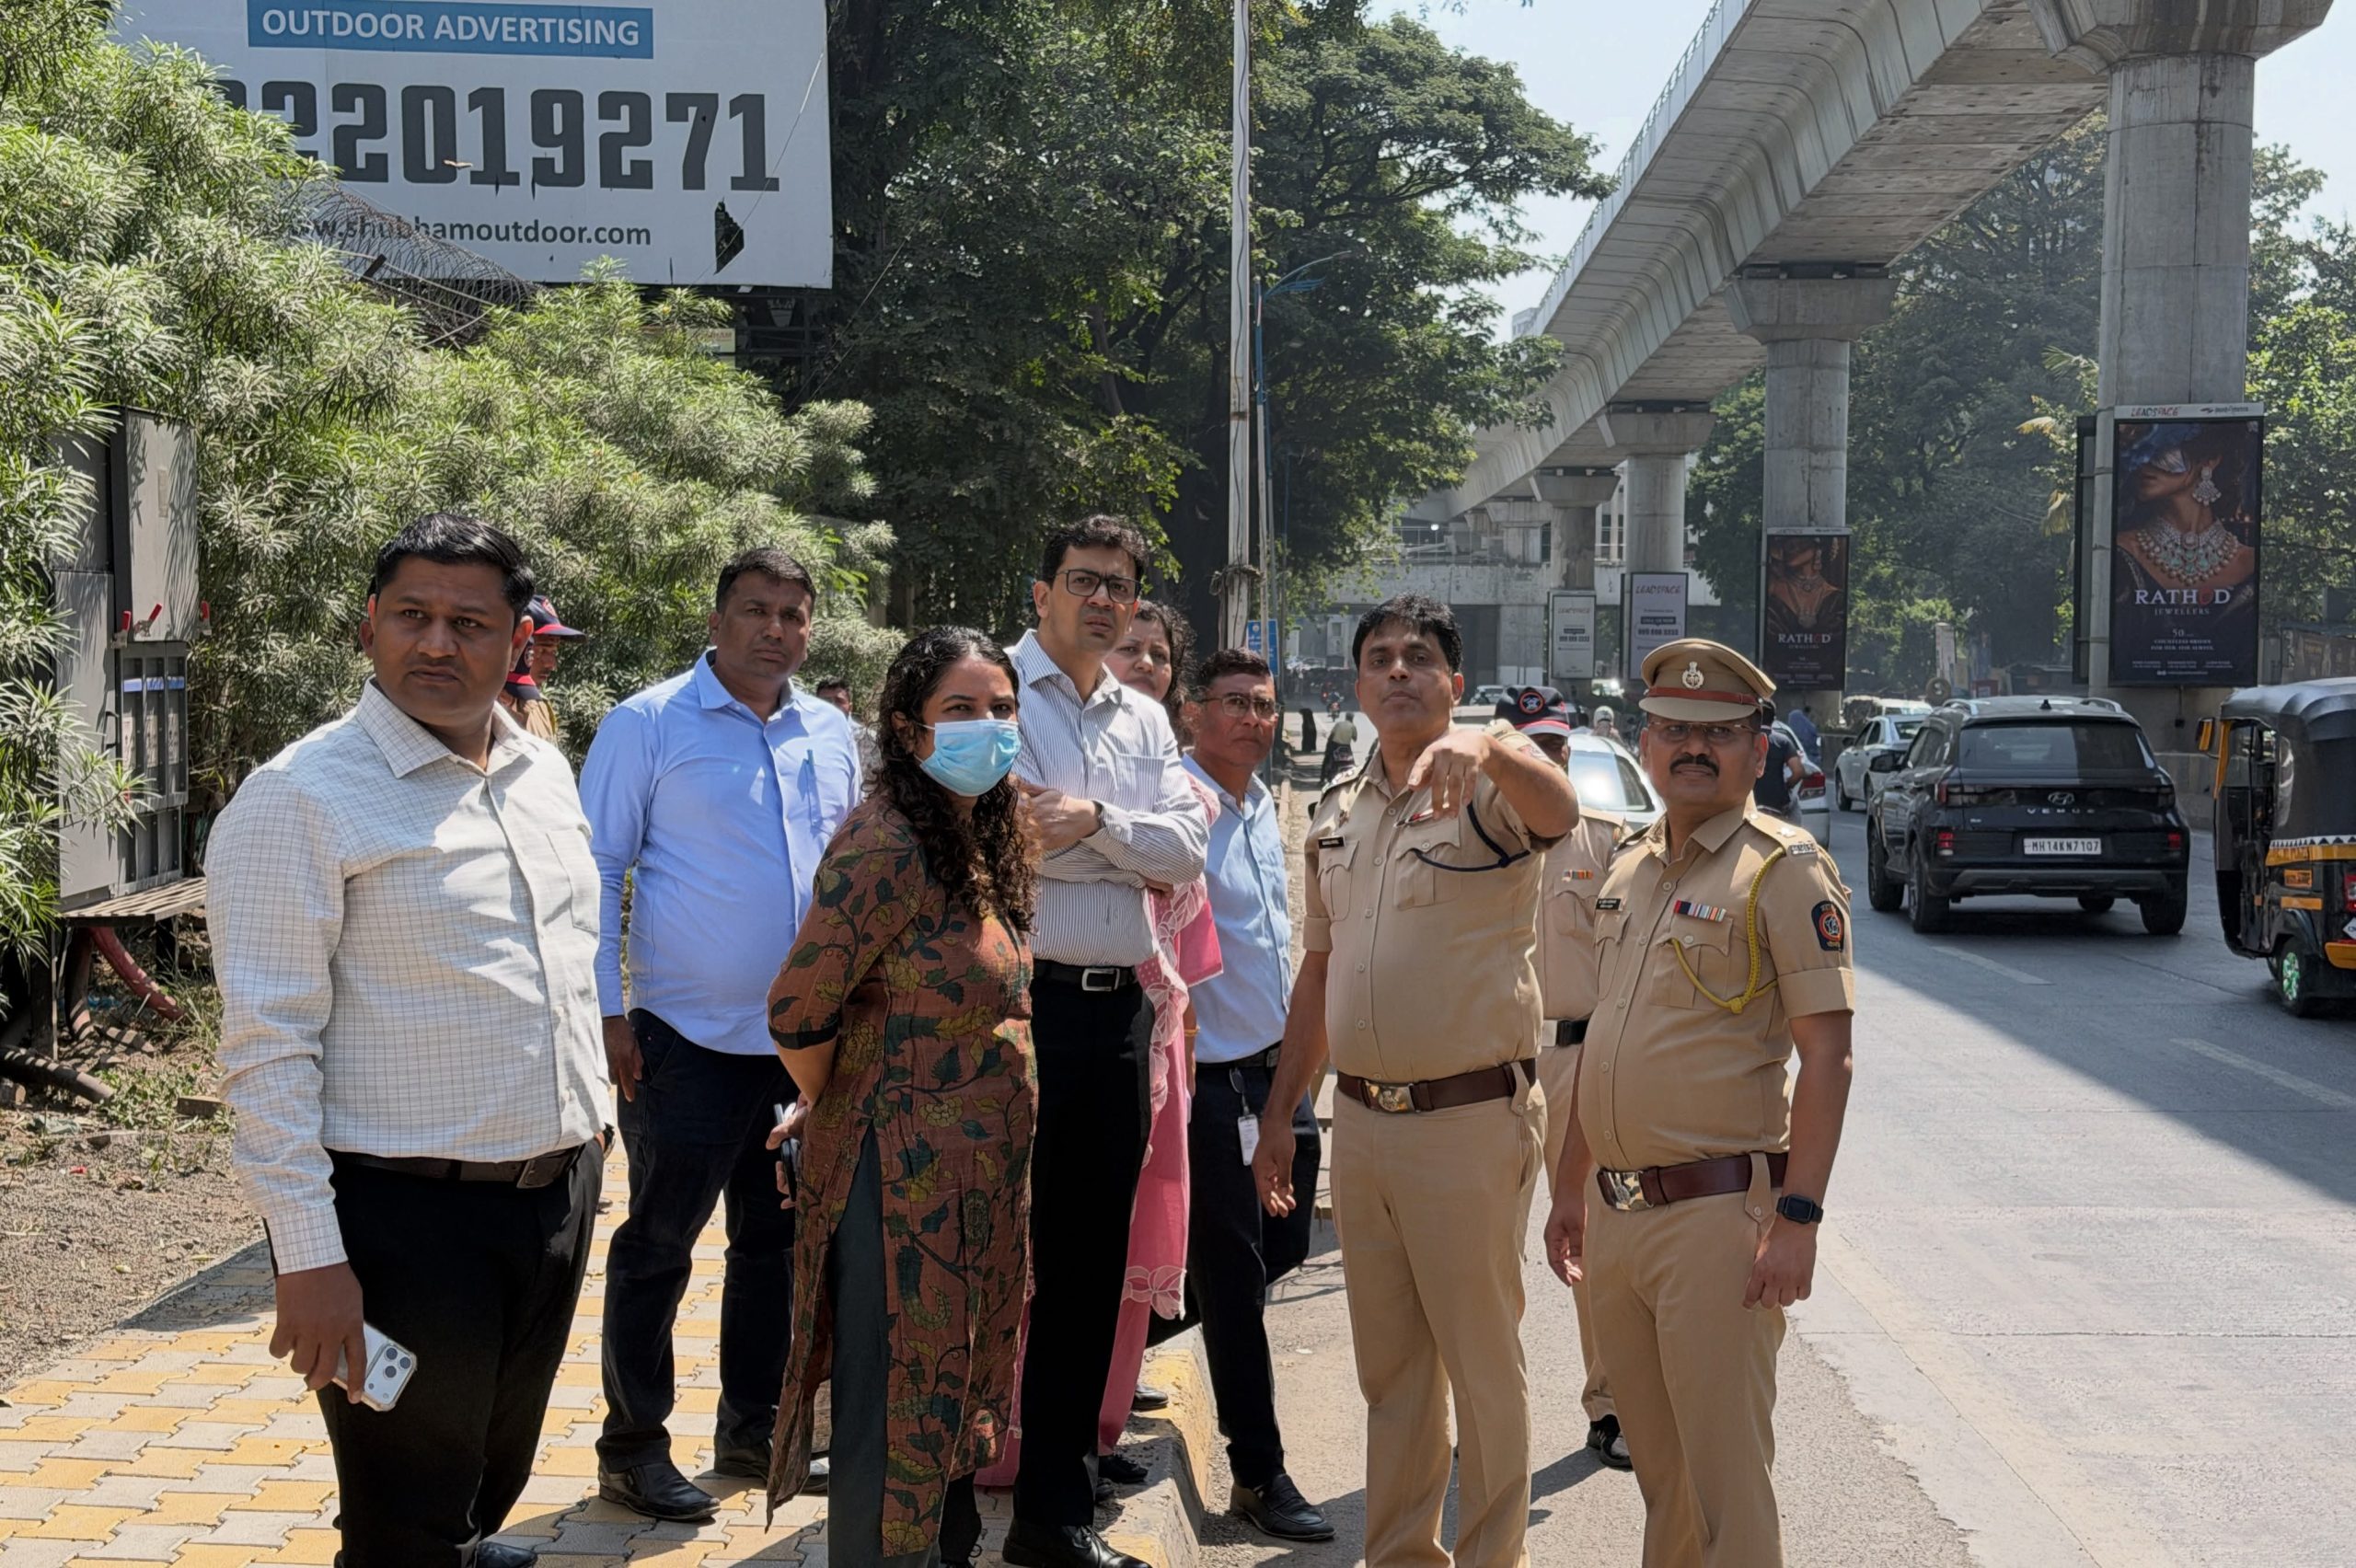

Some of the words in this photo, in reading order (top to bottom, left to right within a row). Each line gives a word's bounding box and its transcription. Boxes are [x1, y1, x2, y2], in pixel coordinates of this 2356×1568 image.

[262, 9, 425, 40] OUTDOOR
[434, 15, 640, 46] ADVERTISING
[214, 79, 780, 191] 22019271
[2134, 588, 2231, 605] RATHOD
[1778, 633, 1831, 643] RATHOD
